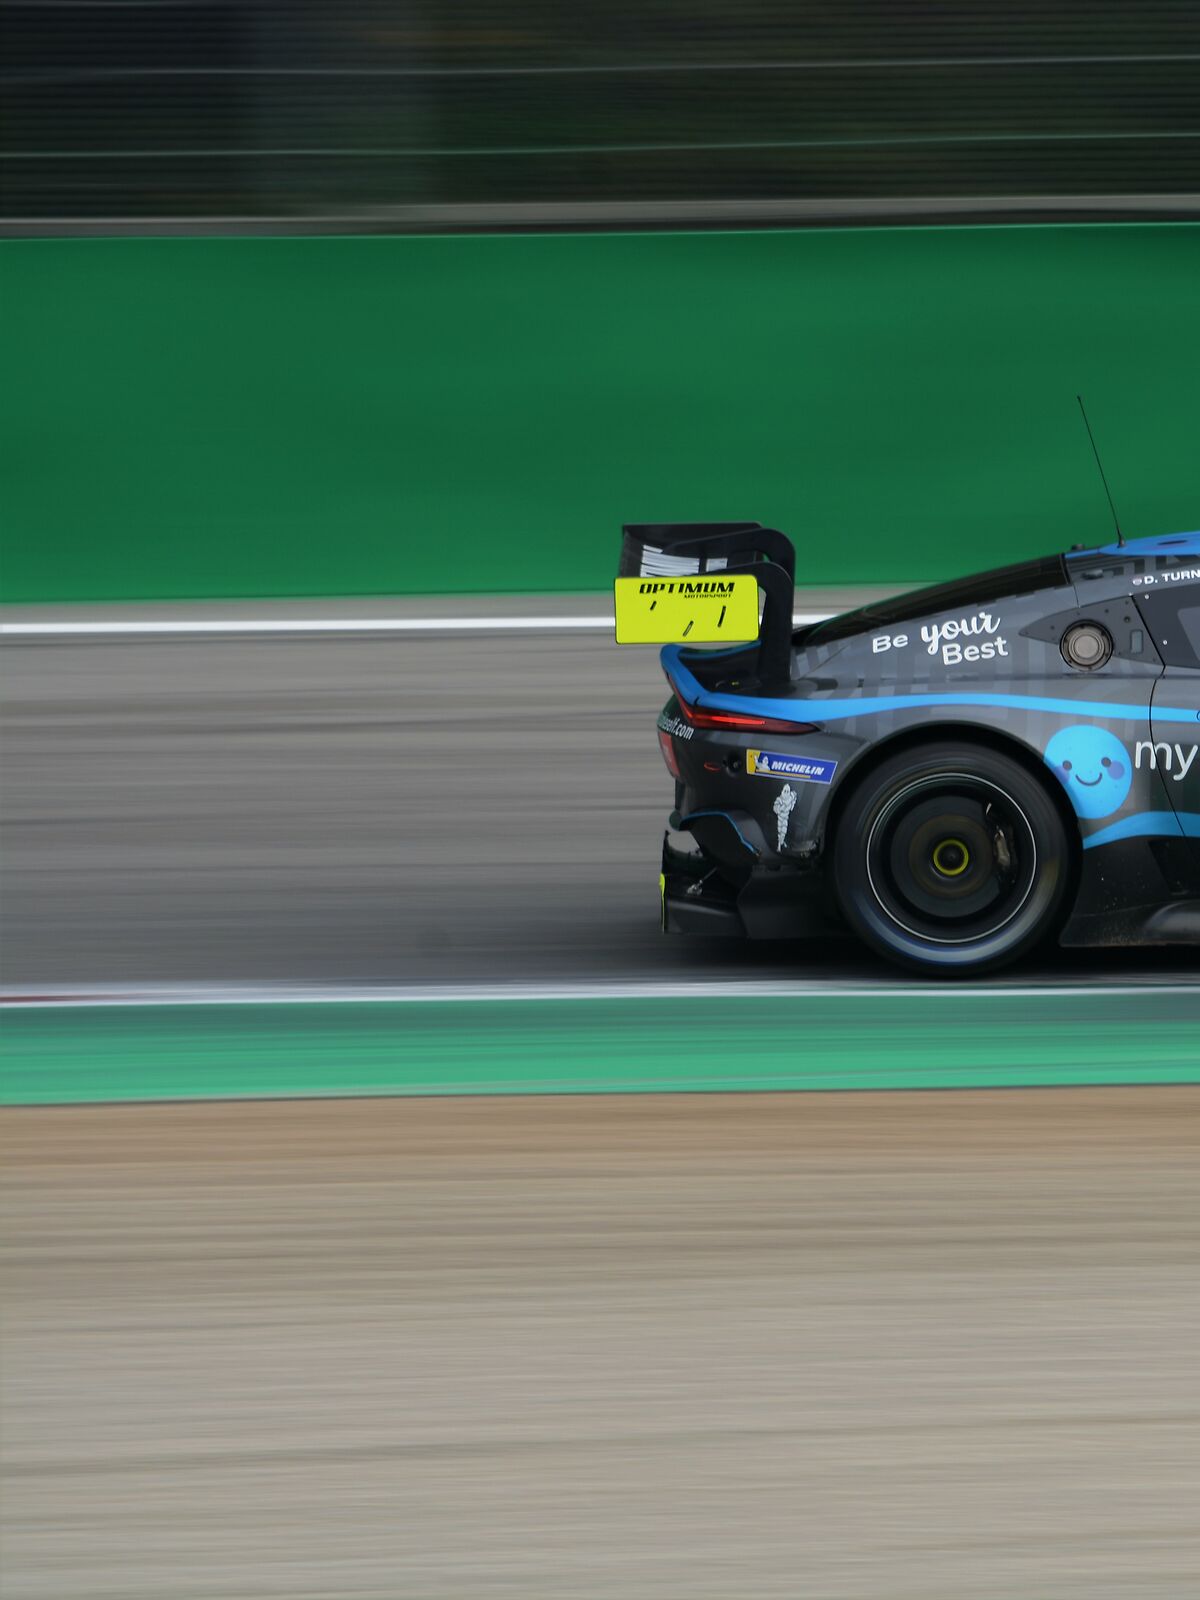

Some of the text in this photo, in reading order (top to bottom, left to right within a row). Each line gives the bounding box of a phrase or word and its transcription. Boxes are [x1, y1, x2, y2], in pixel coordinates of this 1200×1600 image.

[639, 582, 736, 594] OPTIMUM
[1144, 574, 1158, 584] D.
[872, 611, 1001, 656] Be your
[942, 636, 1009, 666] Best
[771, 761, 824, 775] MICHELIN
[1135, 741, 1198, 781] my
